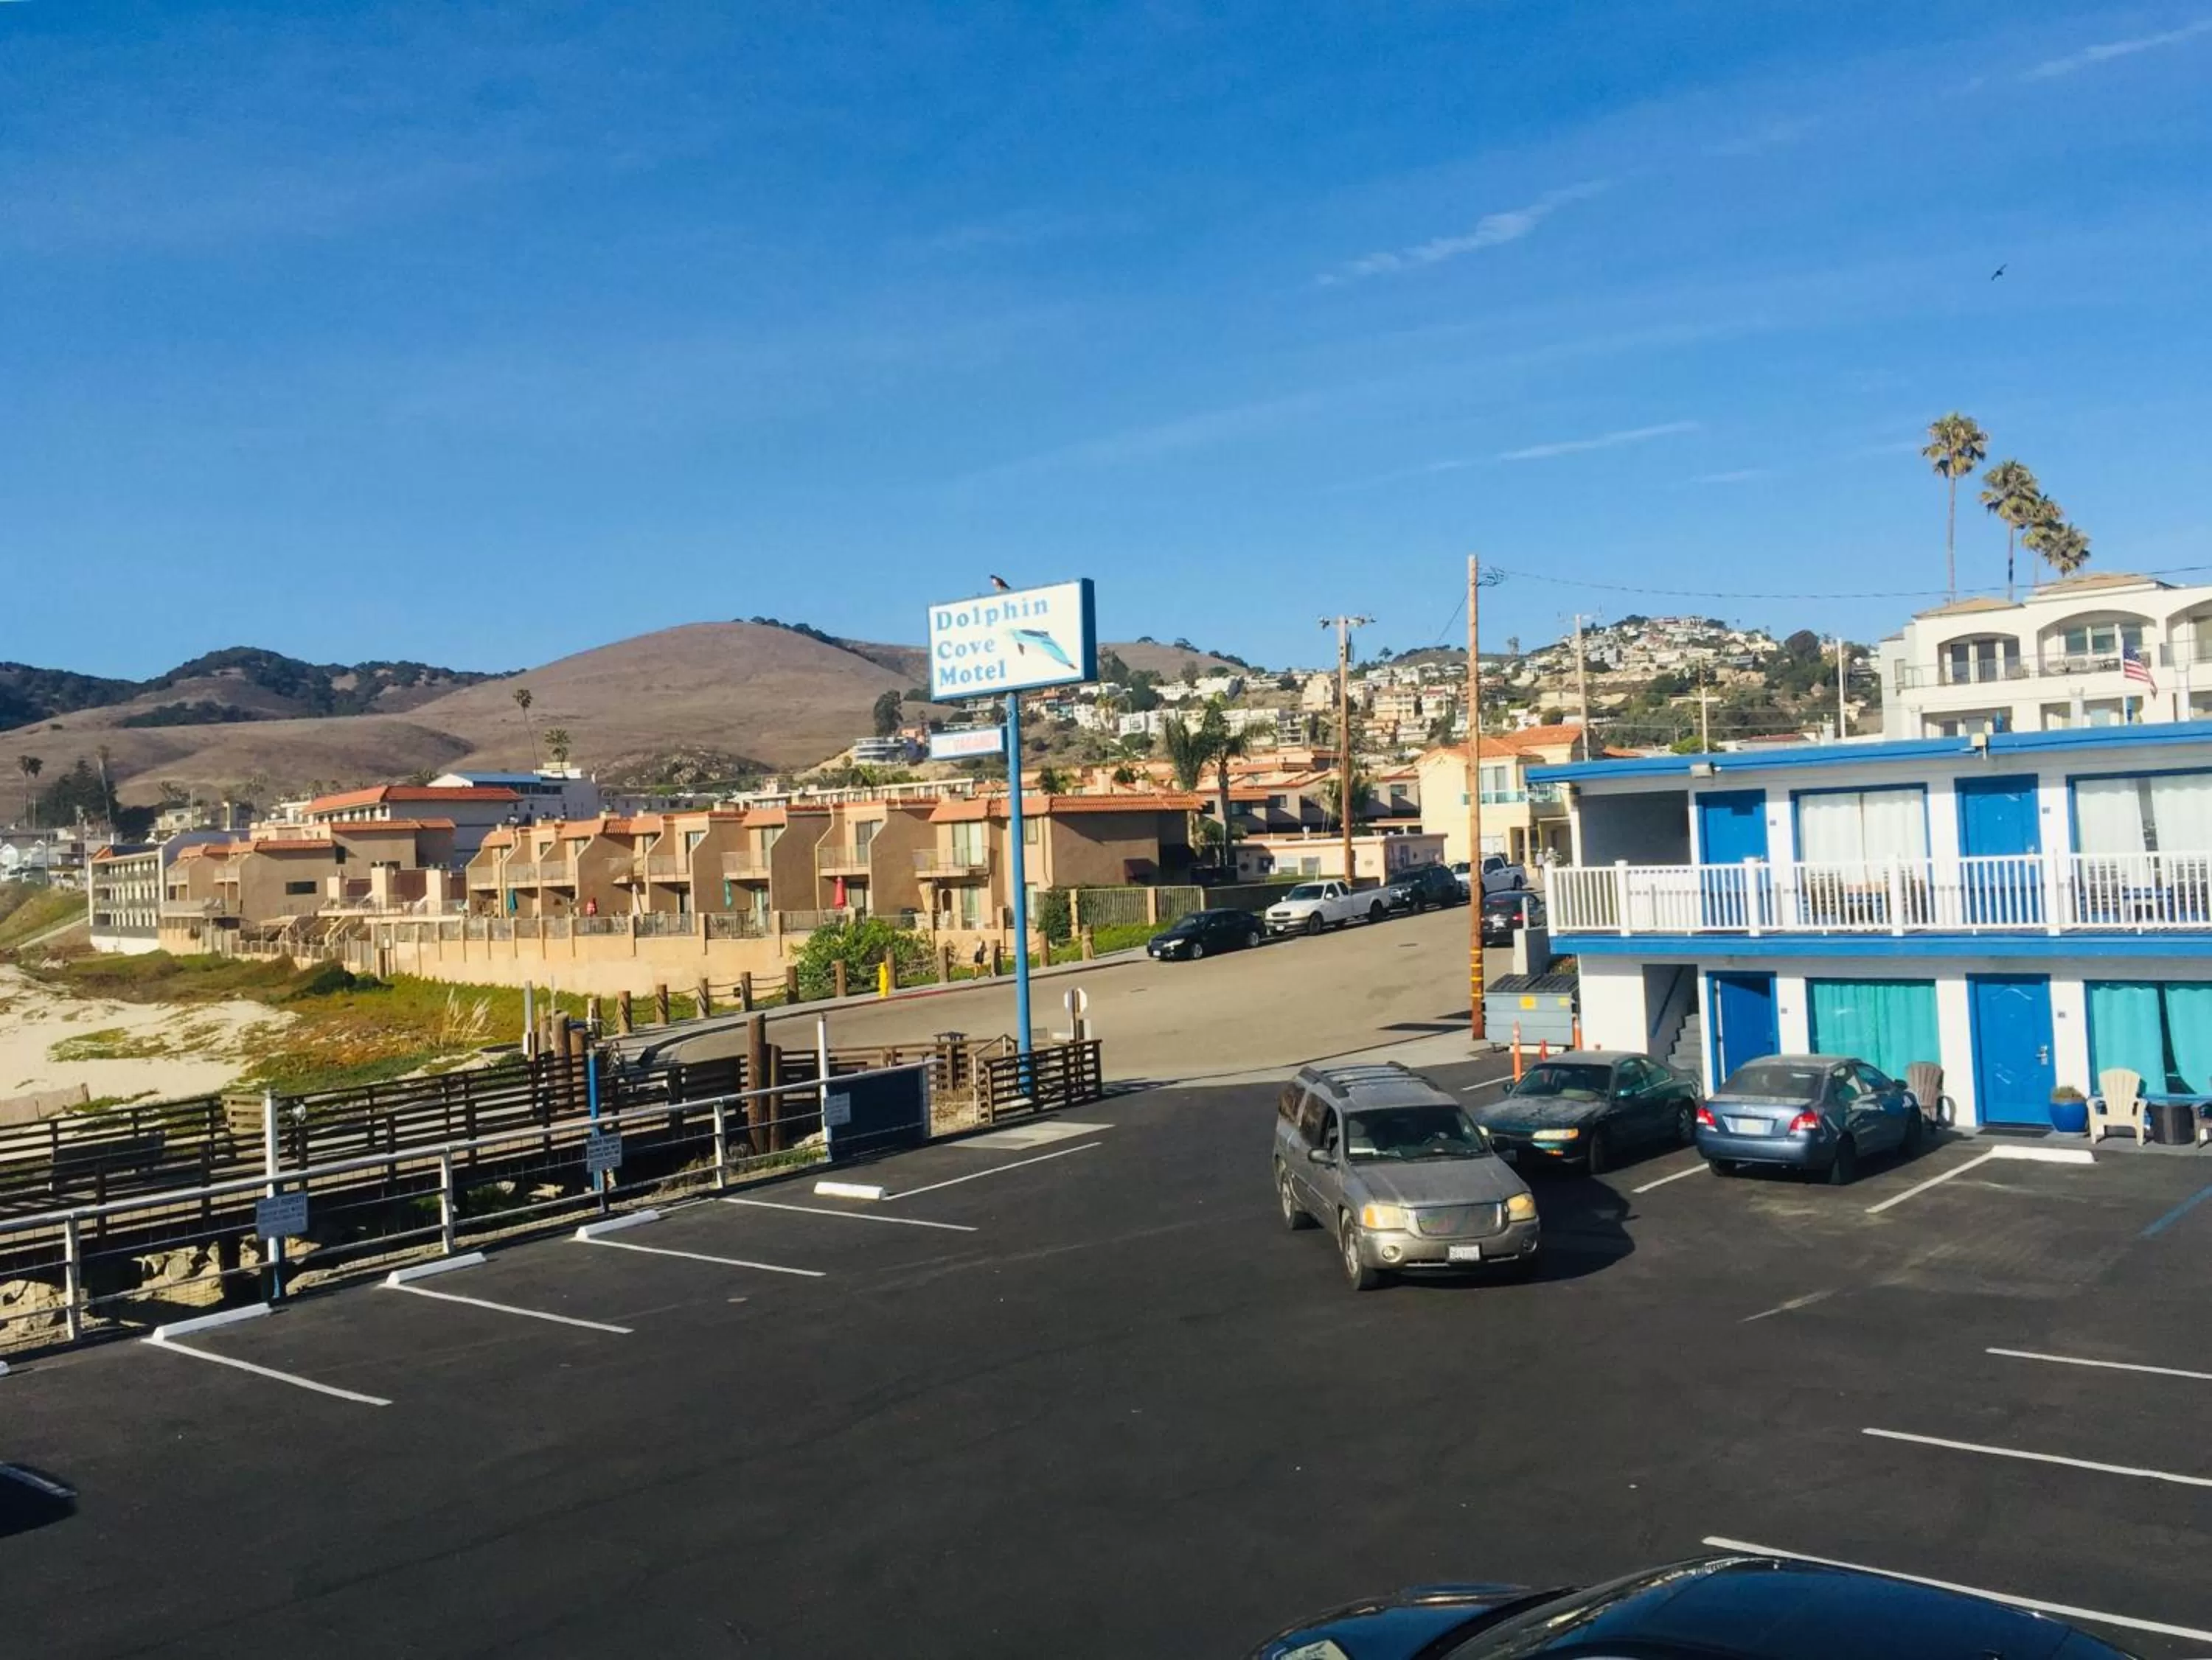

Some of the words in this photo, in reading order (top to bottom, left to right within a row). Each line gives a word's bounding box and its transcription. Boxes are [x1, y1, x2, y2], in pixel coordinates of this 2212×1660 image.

[936, 598, 1048, 631] Dolphin
[937, 638, 995, 660] Cove
[939, 660, 1006, 686] Motel
